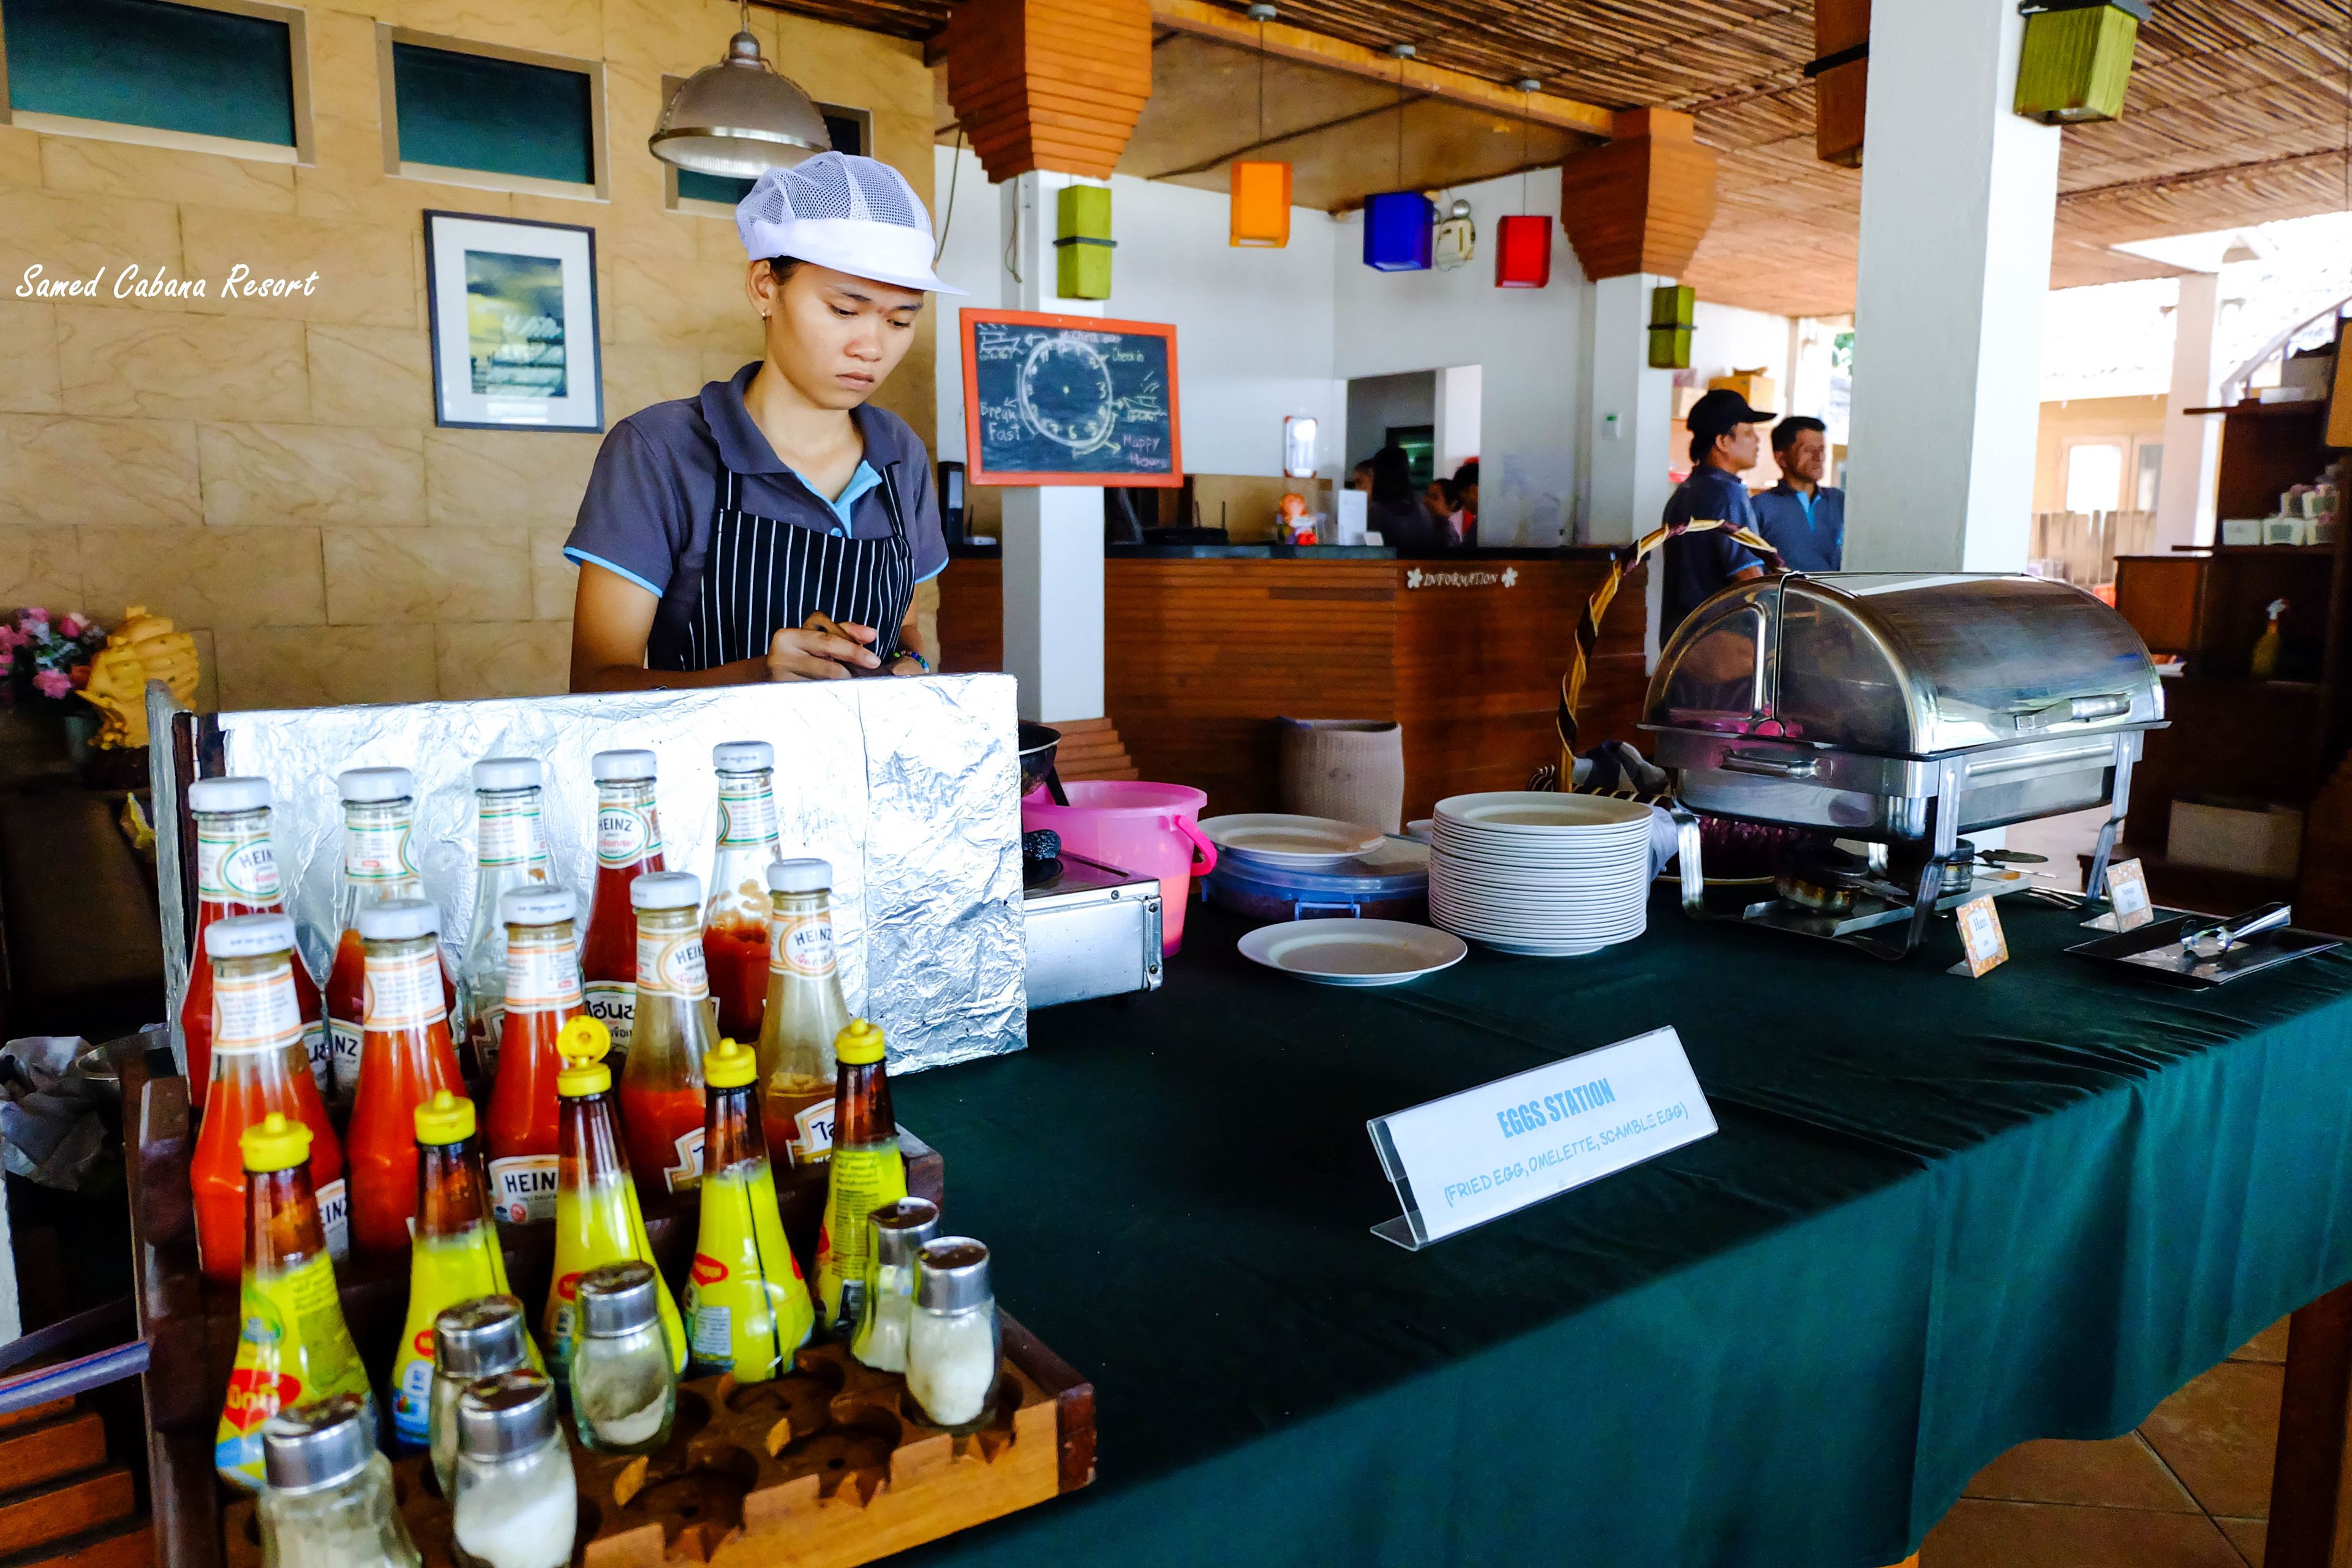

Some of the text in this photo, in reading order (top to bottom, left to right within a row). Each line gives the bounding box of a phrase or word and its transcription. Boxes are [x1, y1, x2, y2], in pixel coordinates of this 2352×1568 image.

[1423, 571, 1500, 587] INFORMATION
[794, 929, 832, 946] HEINZ
[1496, 1078, 1616, 1138] EGGS STATION
[1444, 1174, 1492, 1208] (FRIED
[1599, 1114, 1656, 1145] SCAMBLE
[1657, 1101, 1689, 1125] EGG)
[505, 1172, 556, 1193] HEIN
